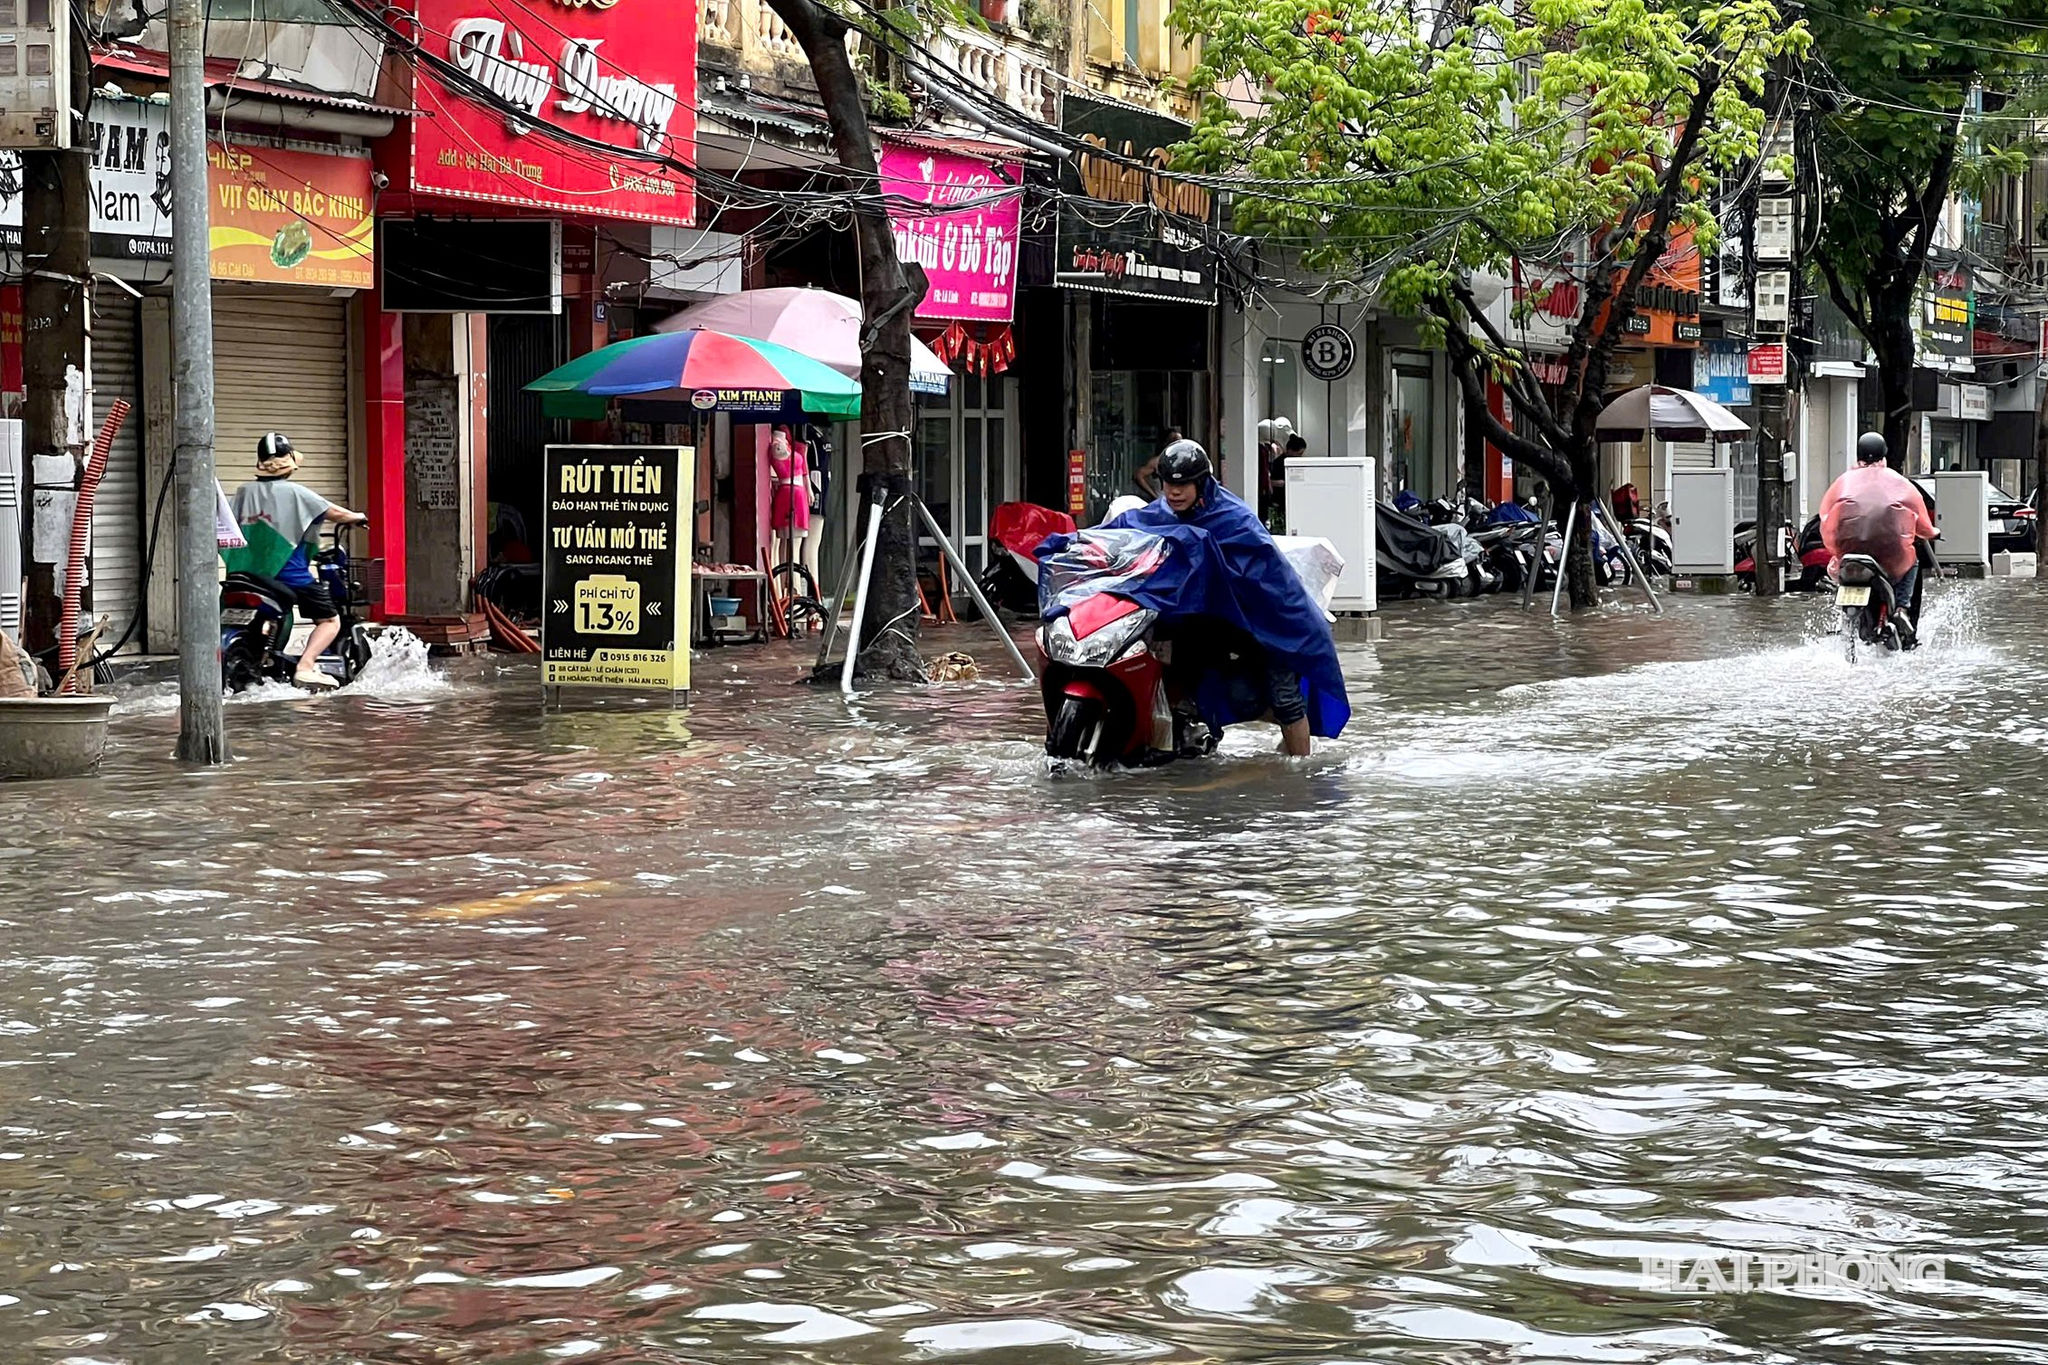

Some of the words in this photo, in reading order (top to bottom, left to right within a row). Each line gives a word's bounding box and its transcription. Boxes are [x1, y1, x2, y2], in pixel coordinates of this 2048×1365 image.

[219, 183, 243, 216] VỊT
[246, 186, 289, 214] QUAY
[293, 181, 325, 216] BẮC
[329, 193, 363, 220] KINH
[984, 226, 1012, 288] Tập
[1318, 341, 1337, 362] B
[717, 390, 740, 401] KIM
[741, 390, 782, 402] THANH
[560, 458, 605, 494] RÚT
[610, 455, 662, 494] TIỀN
[551, 498, 575, 512] ĐÁO
[576, 501, 598, 513] HẠN
[600, 498, 620, 512] THẺ
[621, 499, 639, 512] TÍN
[640, 501, 669, 514] DỤNG
[552, 524, 573, 548] TƯ
[574, 519, 607, 549] VẤN
[610, 521, 637, 549] MỞ
[639, 521, 668, 550] THẺ
[565, 554, 594, 565] SANG
[595, 555, 632, 566] NGANG
[633, 553, 653, 566] THẺ
[579, 587, 598, 599] PHÍ
[600, 588, 618, 599] CHỈ
[619, 588, 635, 600] TỪ
[579, 602, 634, 631] 1.3%
[549, 647, 571, 659] LIÊN
[573, 647, 587, 660] HỆ
[610, 653, 631, 661] 0915
[633, 653, 647, 662] 816
[650, 654, 666, 663] 326
